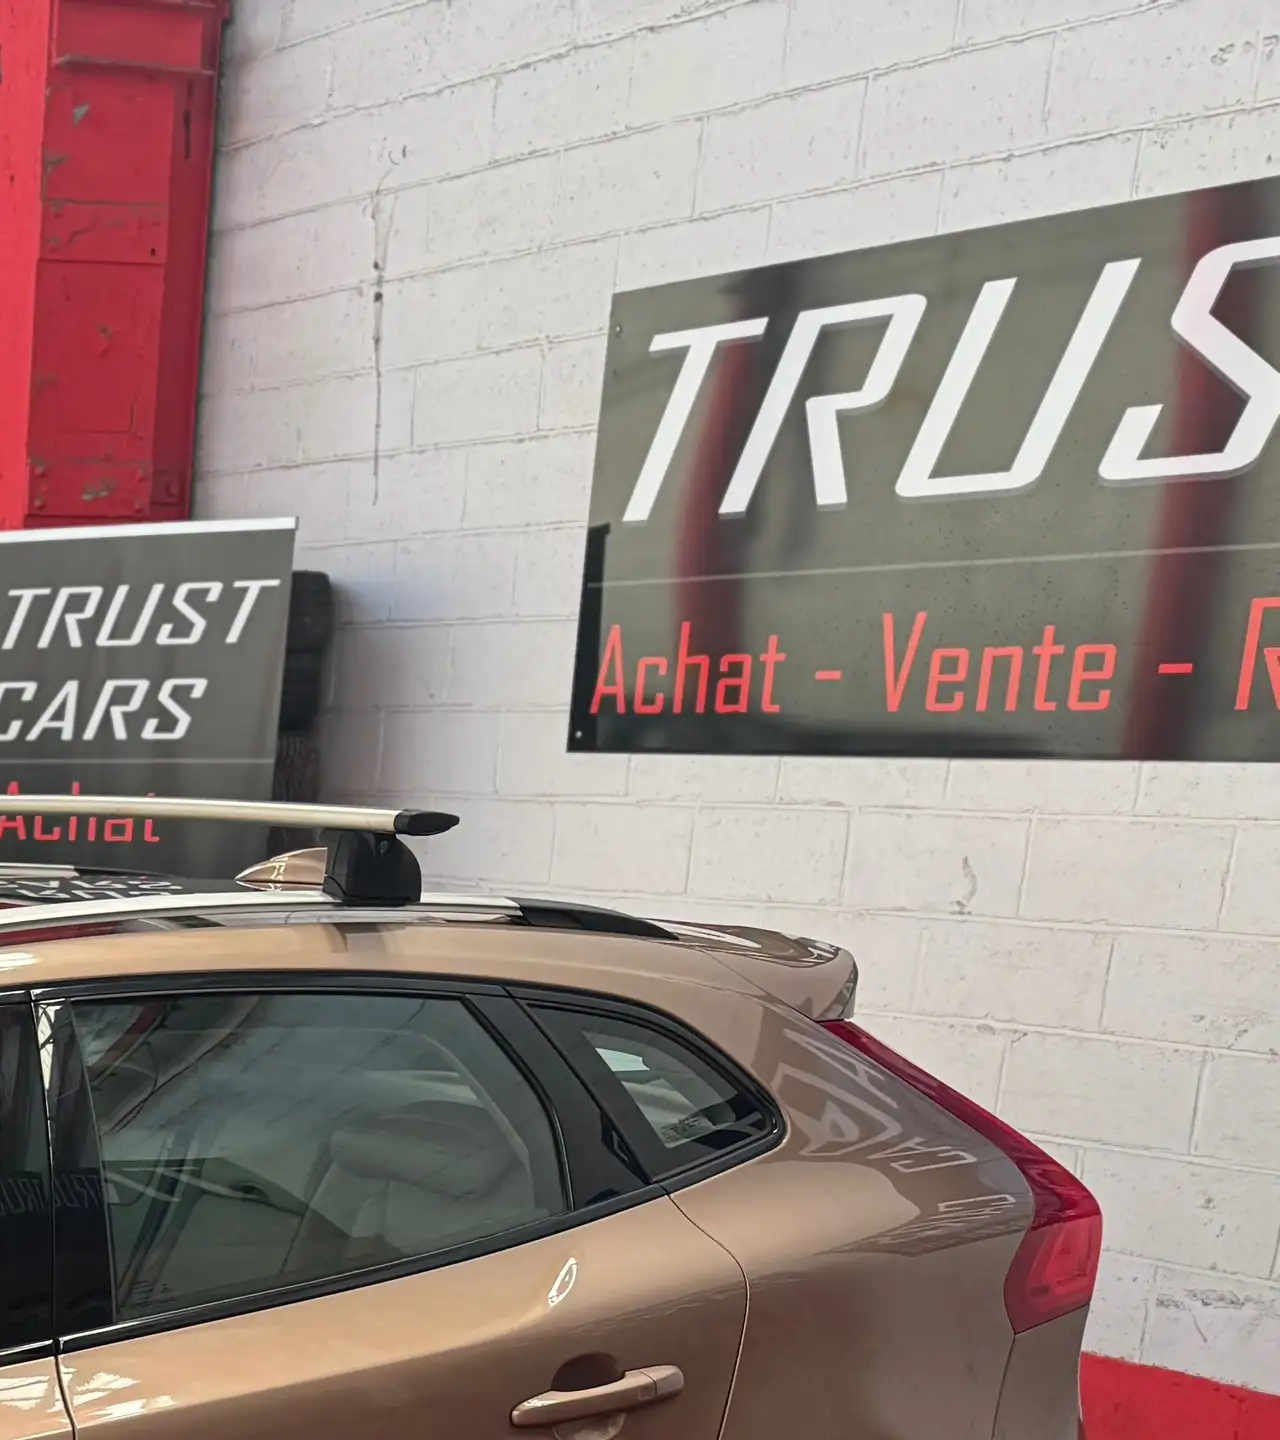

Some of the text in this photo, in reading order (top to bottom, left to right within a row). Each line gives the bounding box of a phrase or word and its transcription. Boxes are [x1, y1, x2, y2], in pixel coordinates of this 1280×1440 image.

[2, 578, 282, 651] TRUST
[590, 622, 786, 715] Achat
[883, 612, 1119, 714] Vente
